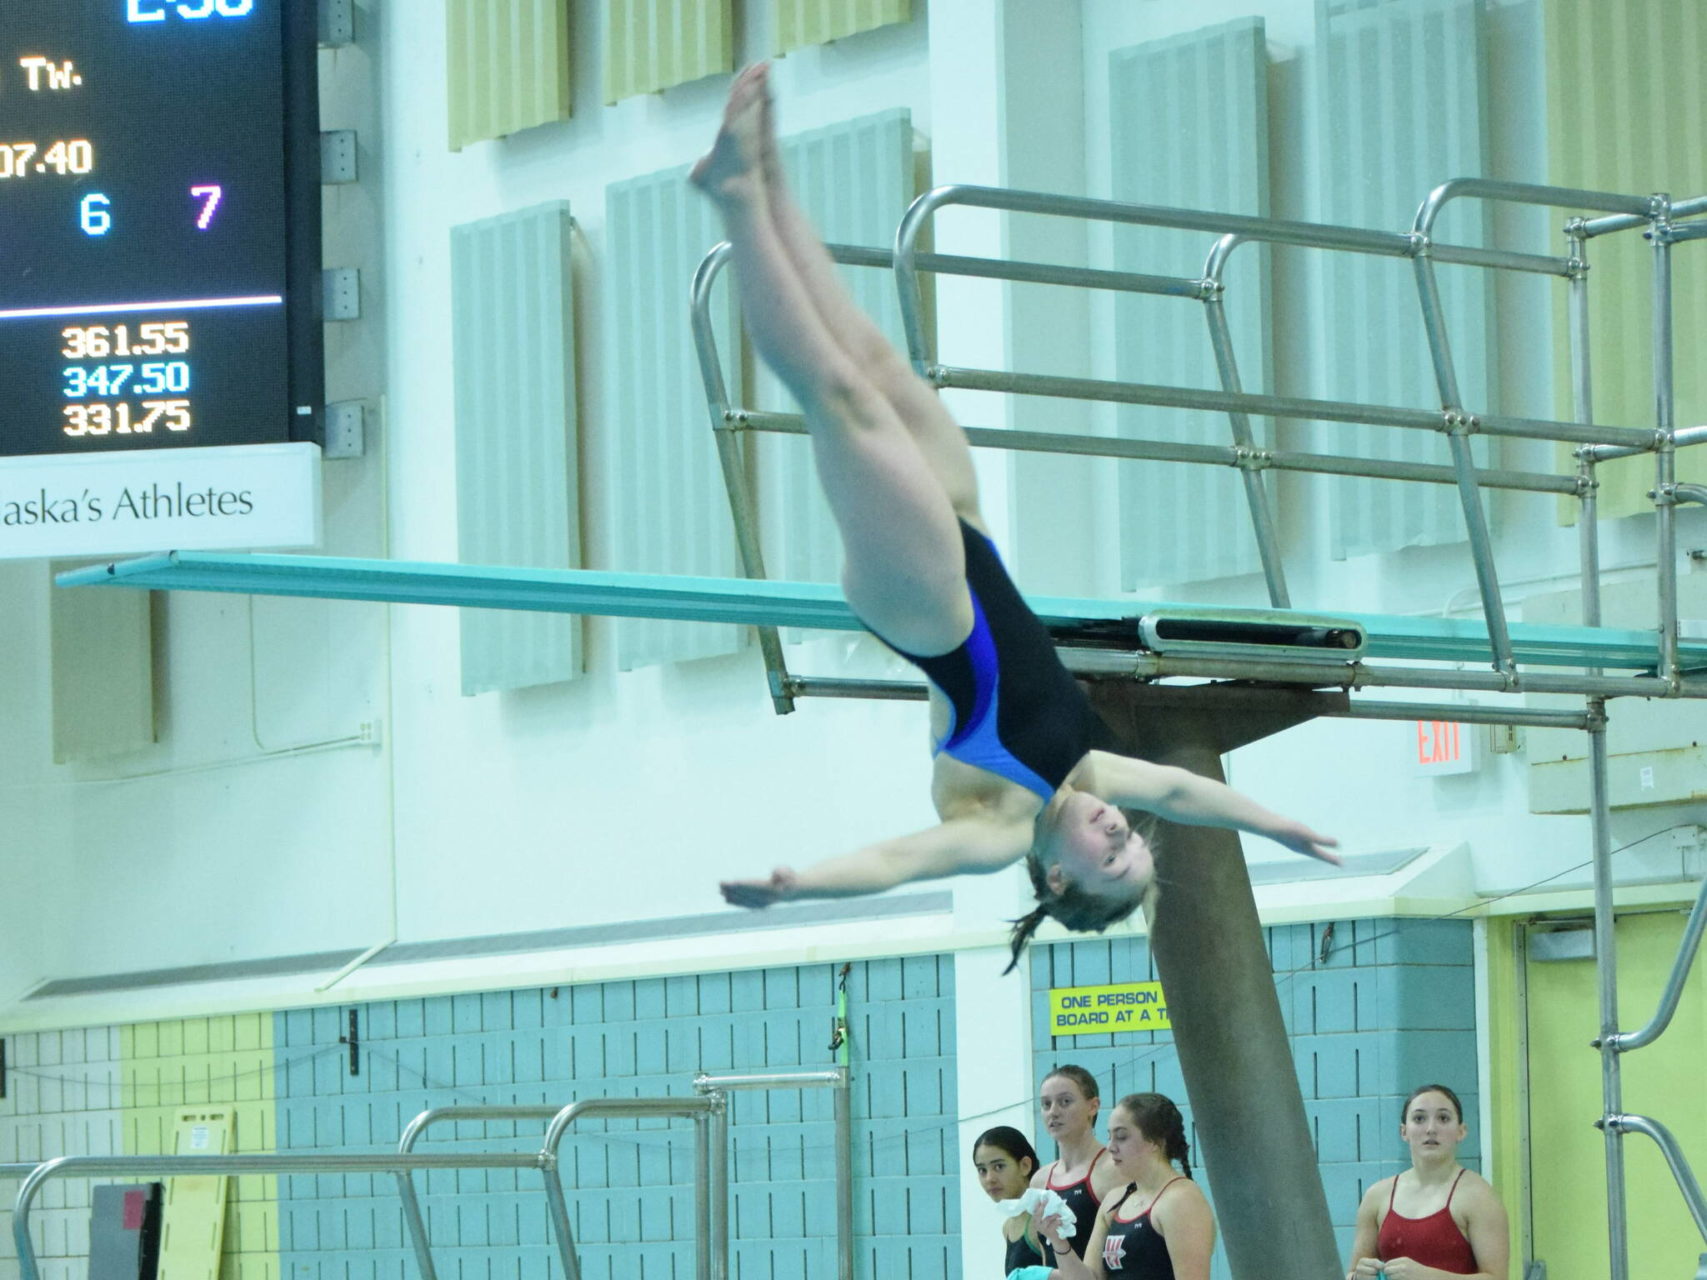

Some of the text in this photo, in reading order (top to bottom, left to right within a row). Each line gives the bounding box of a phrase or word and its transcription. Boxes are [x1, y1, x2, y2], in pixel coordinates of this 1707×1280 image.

[80, 185, 222, 236] 6 7
[62, 321, 189, 359] 361.55
[62, 361, 190, 398] 347.50
[63, 399, 191, 437] 331.75
[112, 481, 254, 521] Athletes
[1056, 1011, 1109, 1026] BOARD
[1115, 1009, 1134, 1023] AT
[1140, 1008, 1151, 1022] A
[1061, 991, 1158, 1009] ONE PERSON
